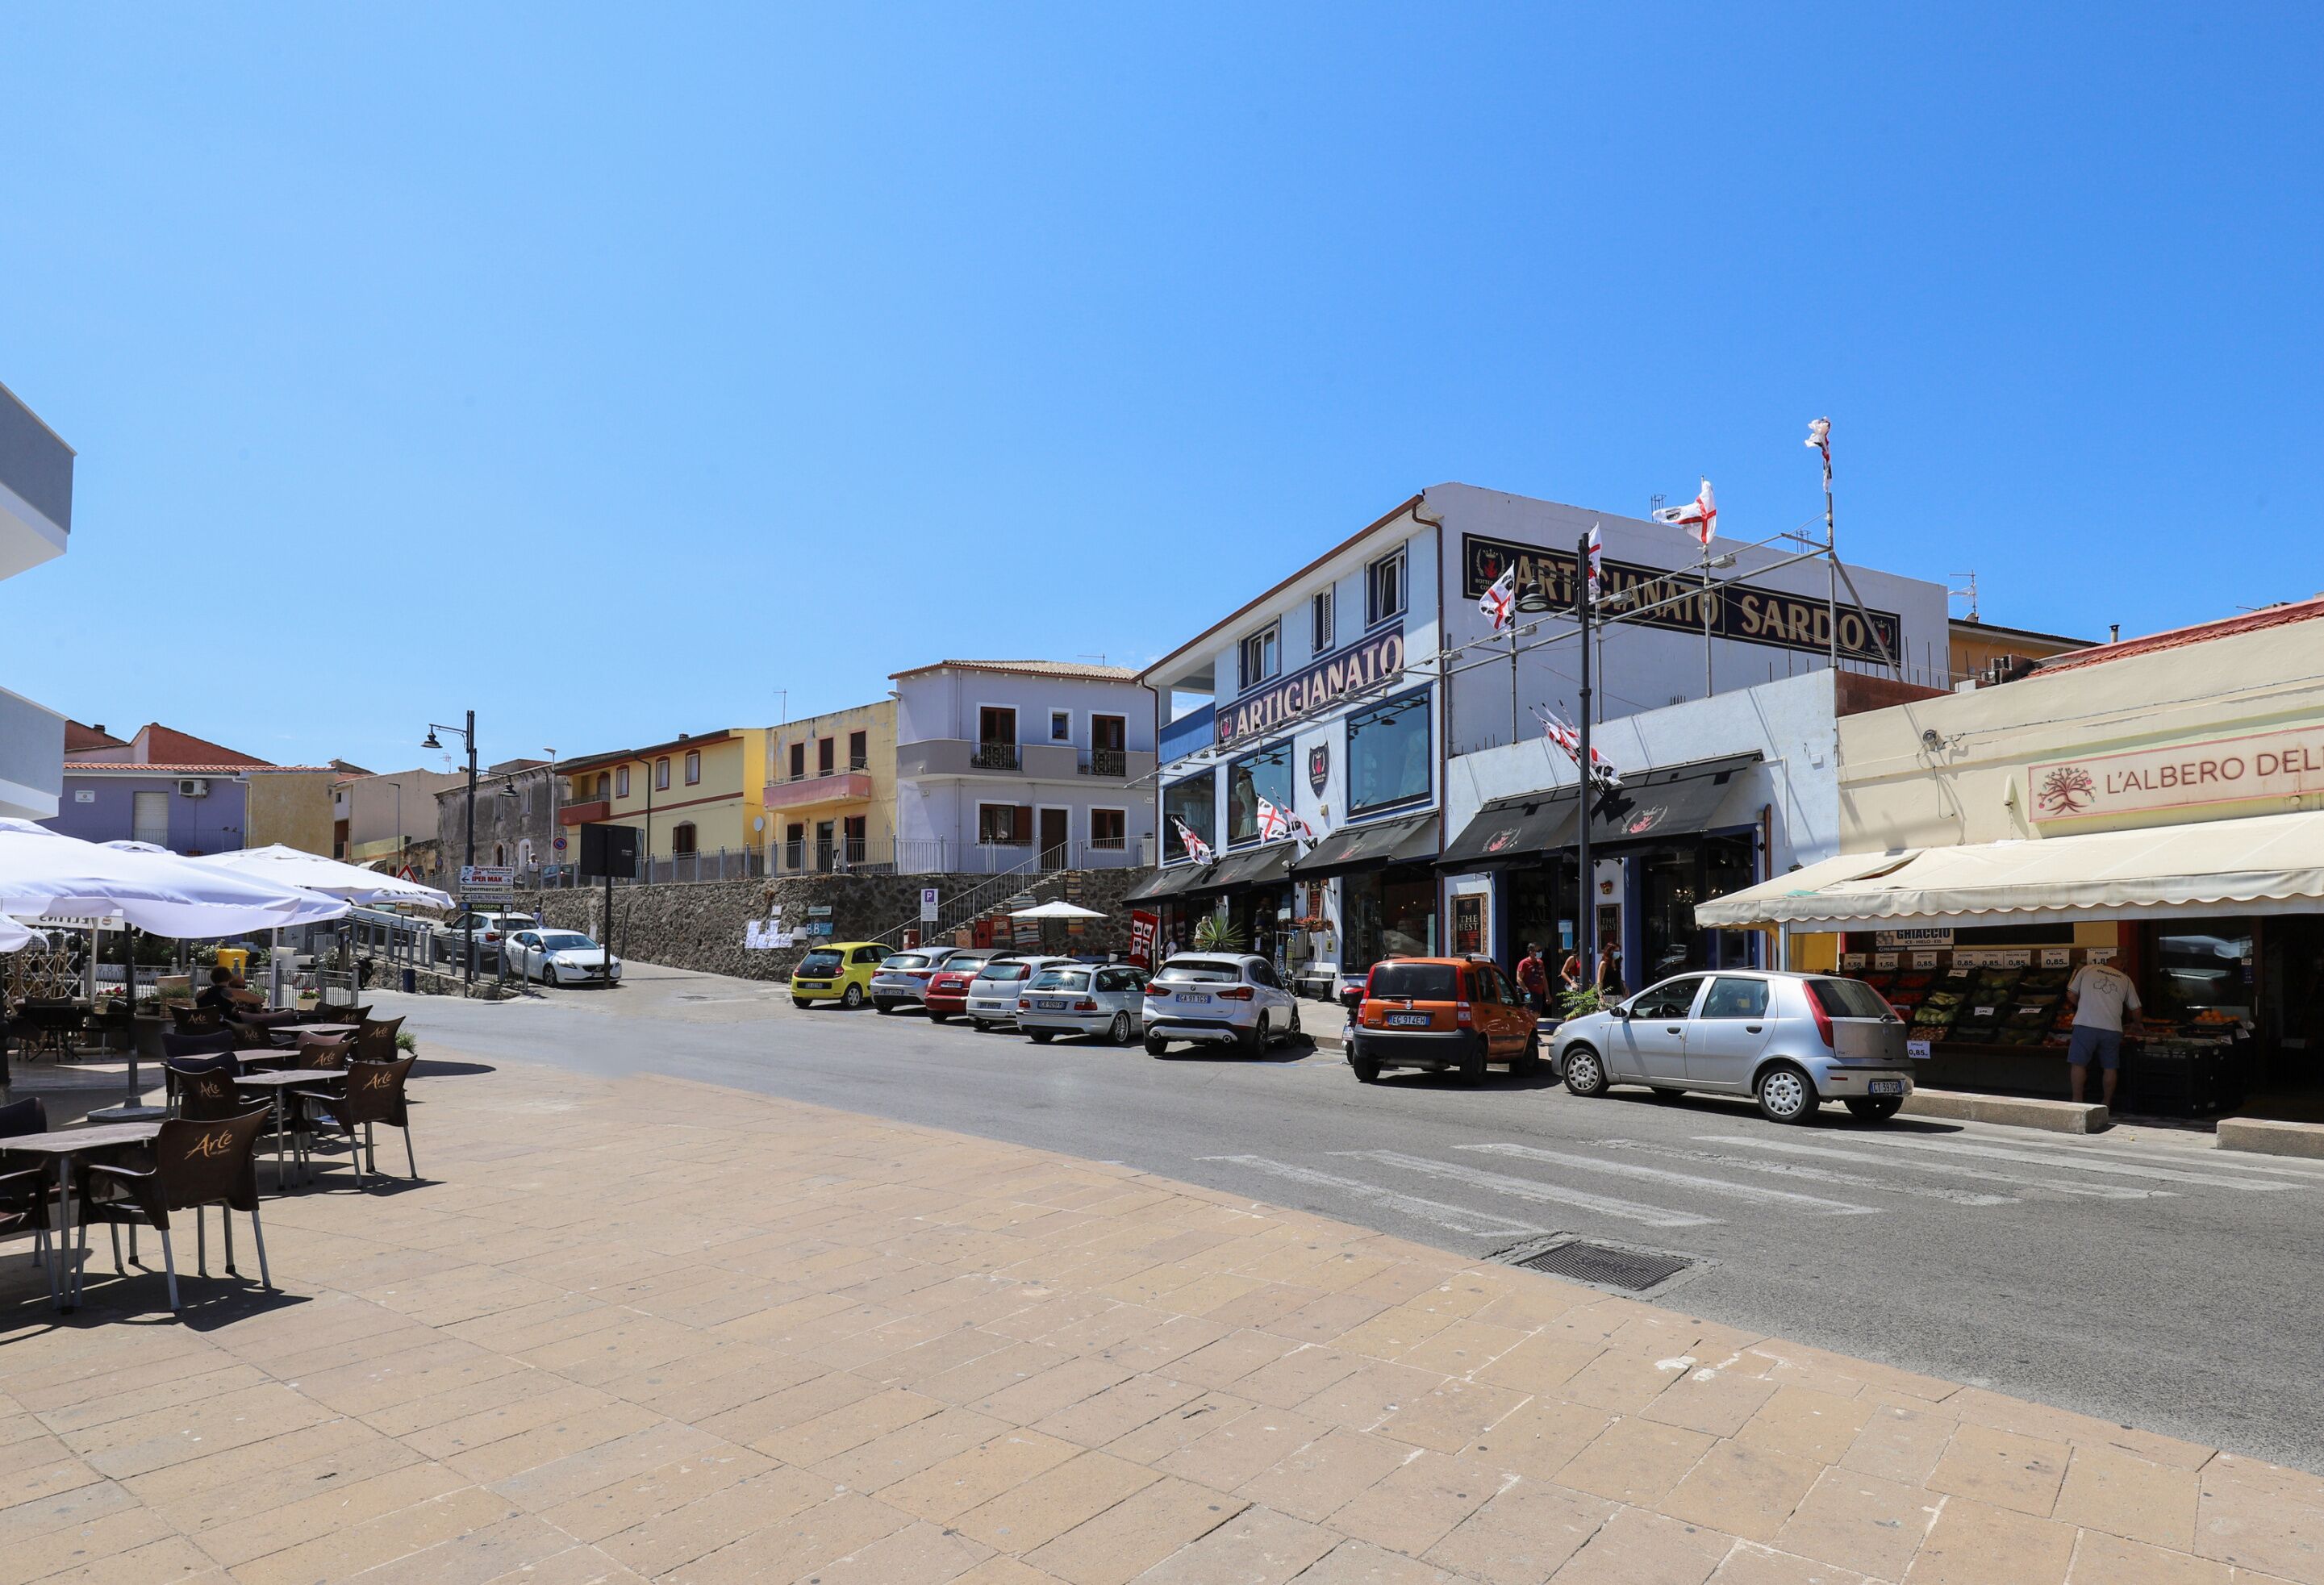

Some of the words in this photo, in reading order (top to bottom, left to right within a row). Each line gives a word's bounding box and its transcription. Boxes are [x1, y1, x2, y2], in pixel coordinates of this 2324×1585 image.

[1741, 594, 1865, 650] SARDO
[1237, 634, 1404, 739] ARTIGIANATO
[2107, 757, 2245, 795] L'ALBERO
[2257, 745, 2324, 777] DEL
[1459, 915, 1478, 923] THE
[1459, 923, 1479, 932] BEST
[200, 1081, 220, 1097] Arte
[363, 1070, 392, 1091] Arte
[1873, 1082, 1881, 1092] CT
[184, 1129, 232, 1160] Arte
